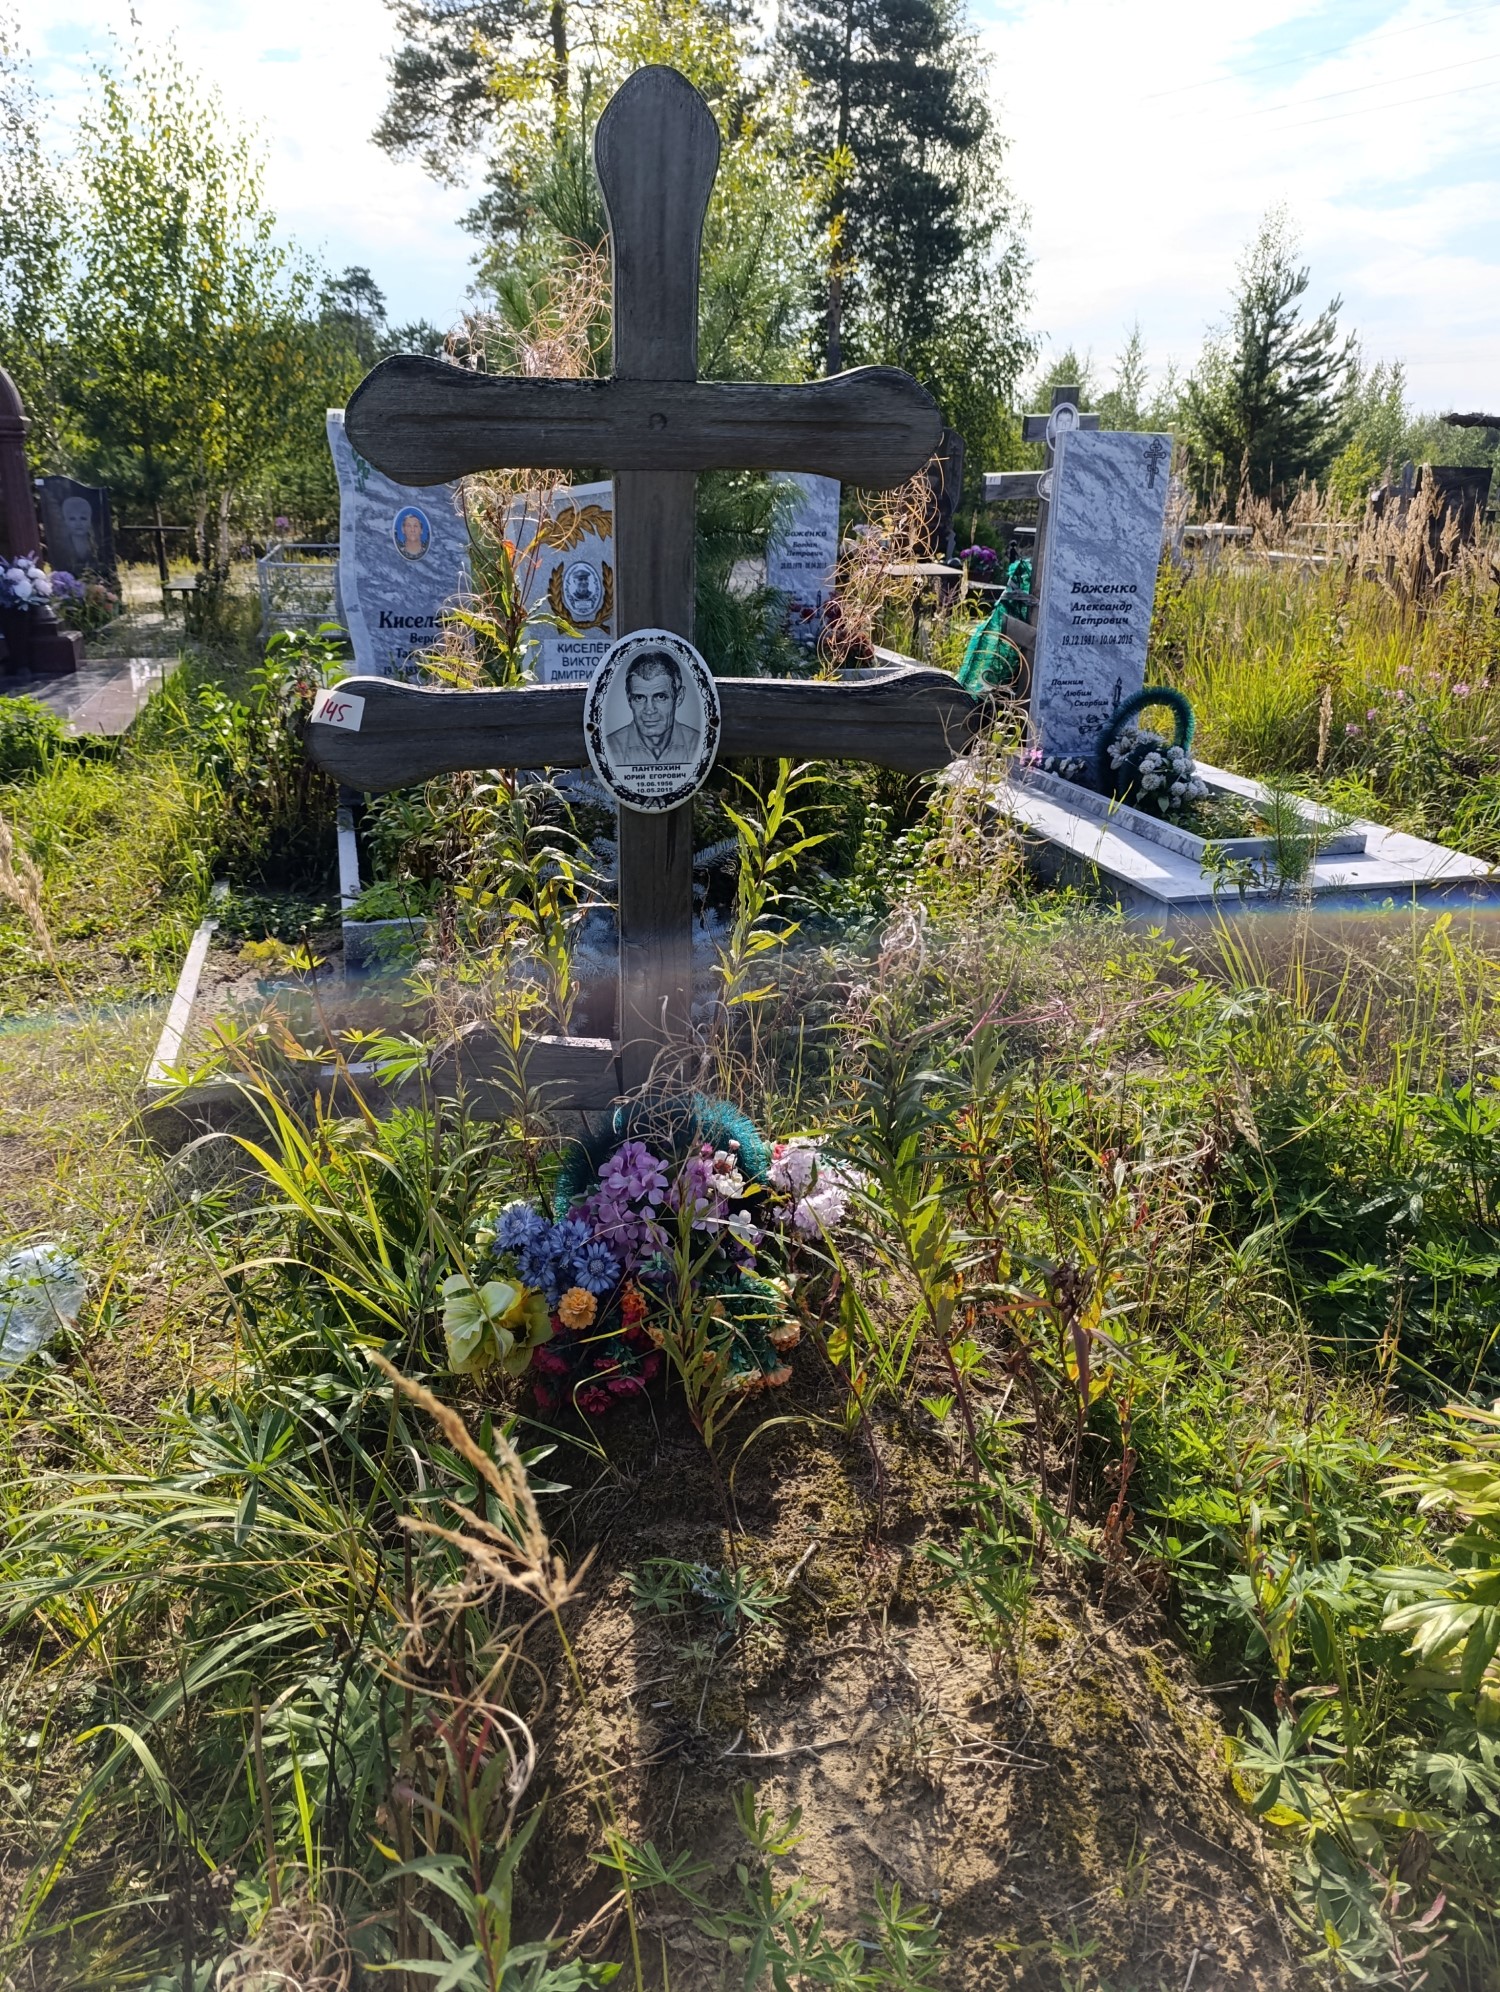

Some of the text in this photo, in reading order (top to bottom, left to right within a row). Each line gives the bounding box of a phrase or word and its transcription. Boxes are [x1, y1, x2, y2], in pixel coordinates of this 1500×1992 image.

[1070, 582, 1138, 594] Боженко
[1071, 600, 1133, 613] Александр
[1072, 615, 1129, 627] Петрович
[562, 656, 604, 667] ВИКТО
[551, 670, 594, 682] ДМИТРИ
[1051, 678, 1084, 686] Помним
[1063, 689, 1092, 697] Любим
[1074, 699, 1109, 708] Скорбим
[319, 698, 353, 722] 145
[631, 764, 681, 773] ПАНТЮХИН
[623, 773, 646, 781] ЮРИЙ
